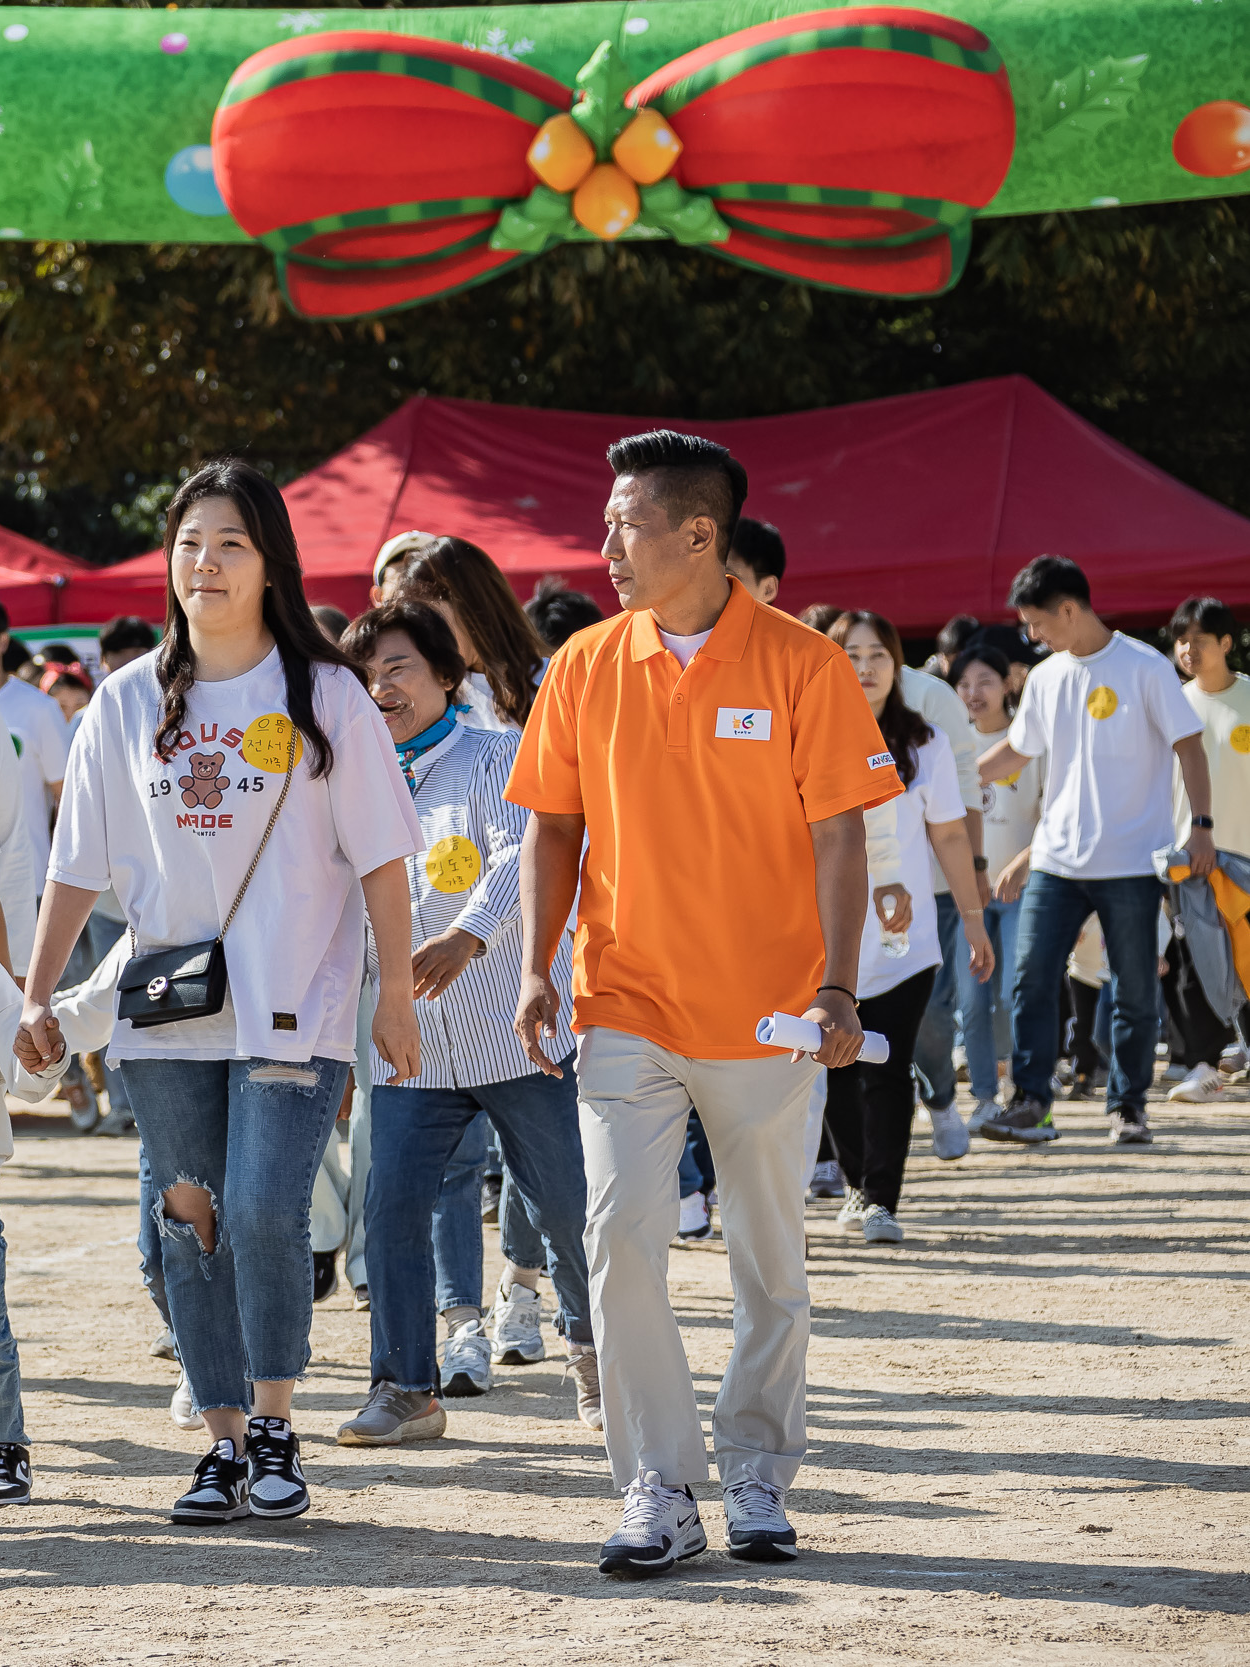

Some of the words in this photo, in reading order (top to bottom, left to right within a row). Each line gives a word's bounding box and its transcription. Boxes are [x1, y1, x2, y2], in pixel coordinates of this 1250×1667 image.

[257, 718, 286, 734] 으뜸
[262, 756, 281, 768] 가족
[148, 779, 172, 798] 19
[237, 776, 265, 793] 45
